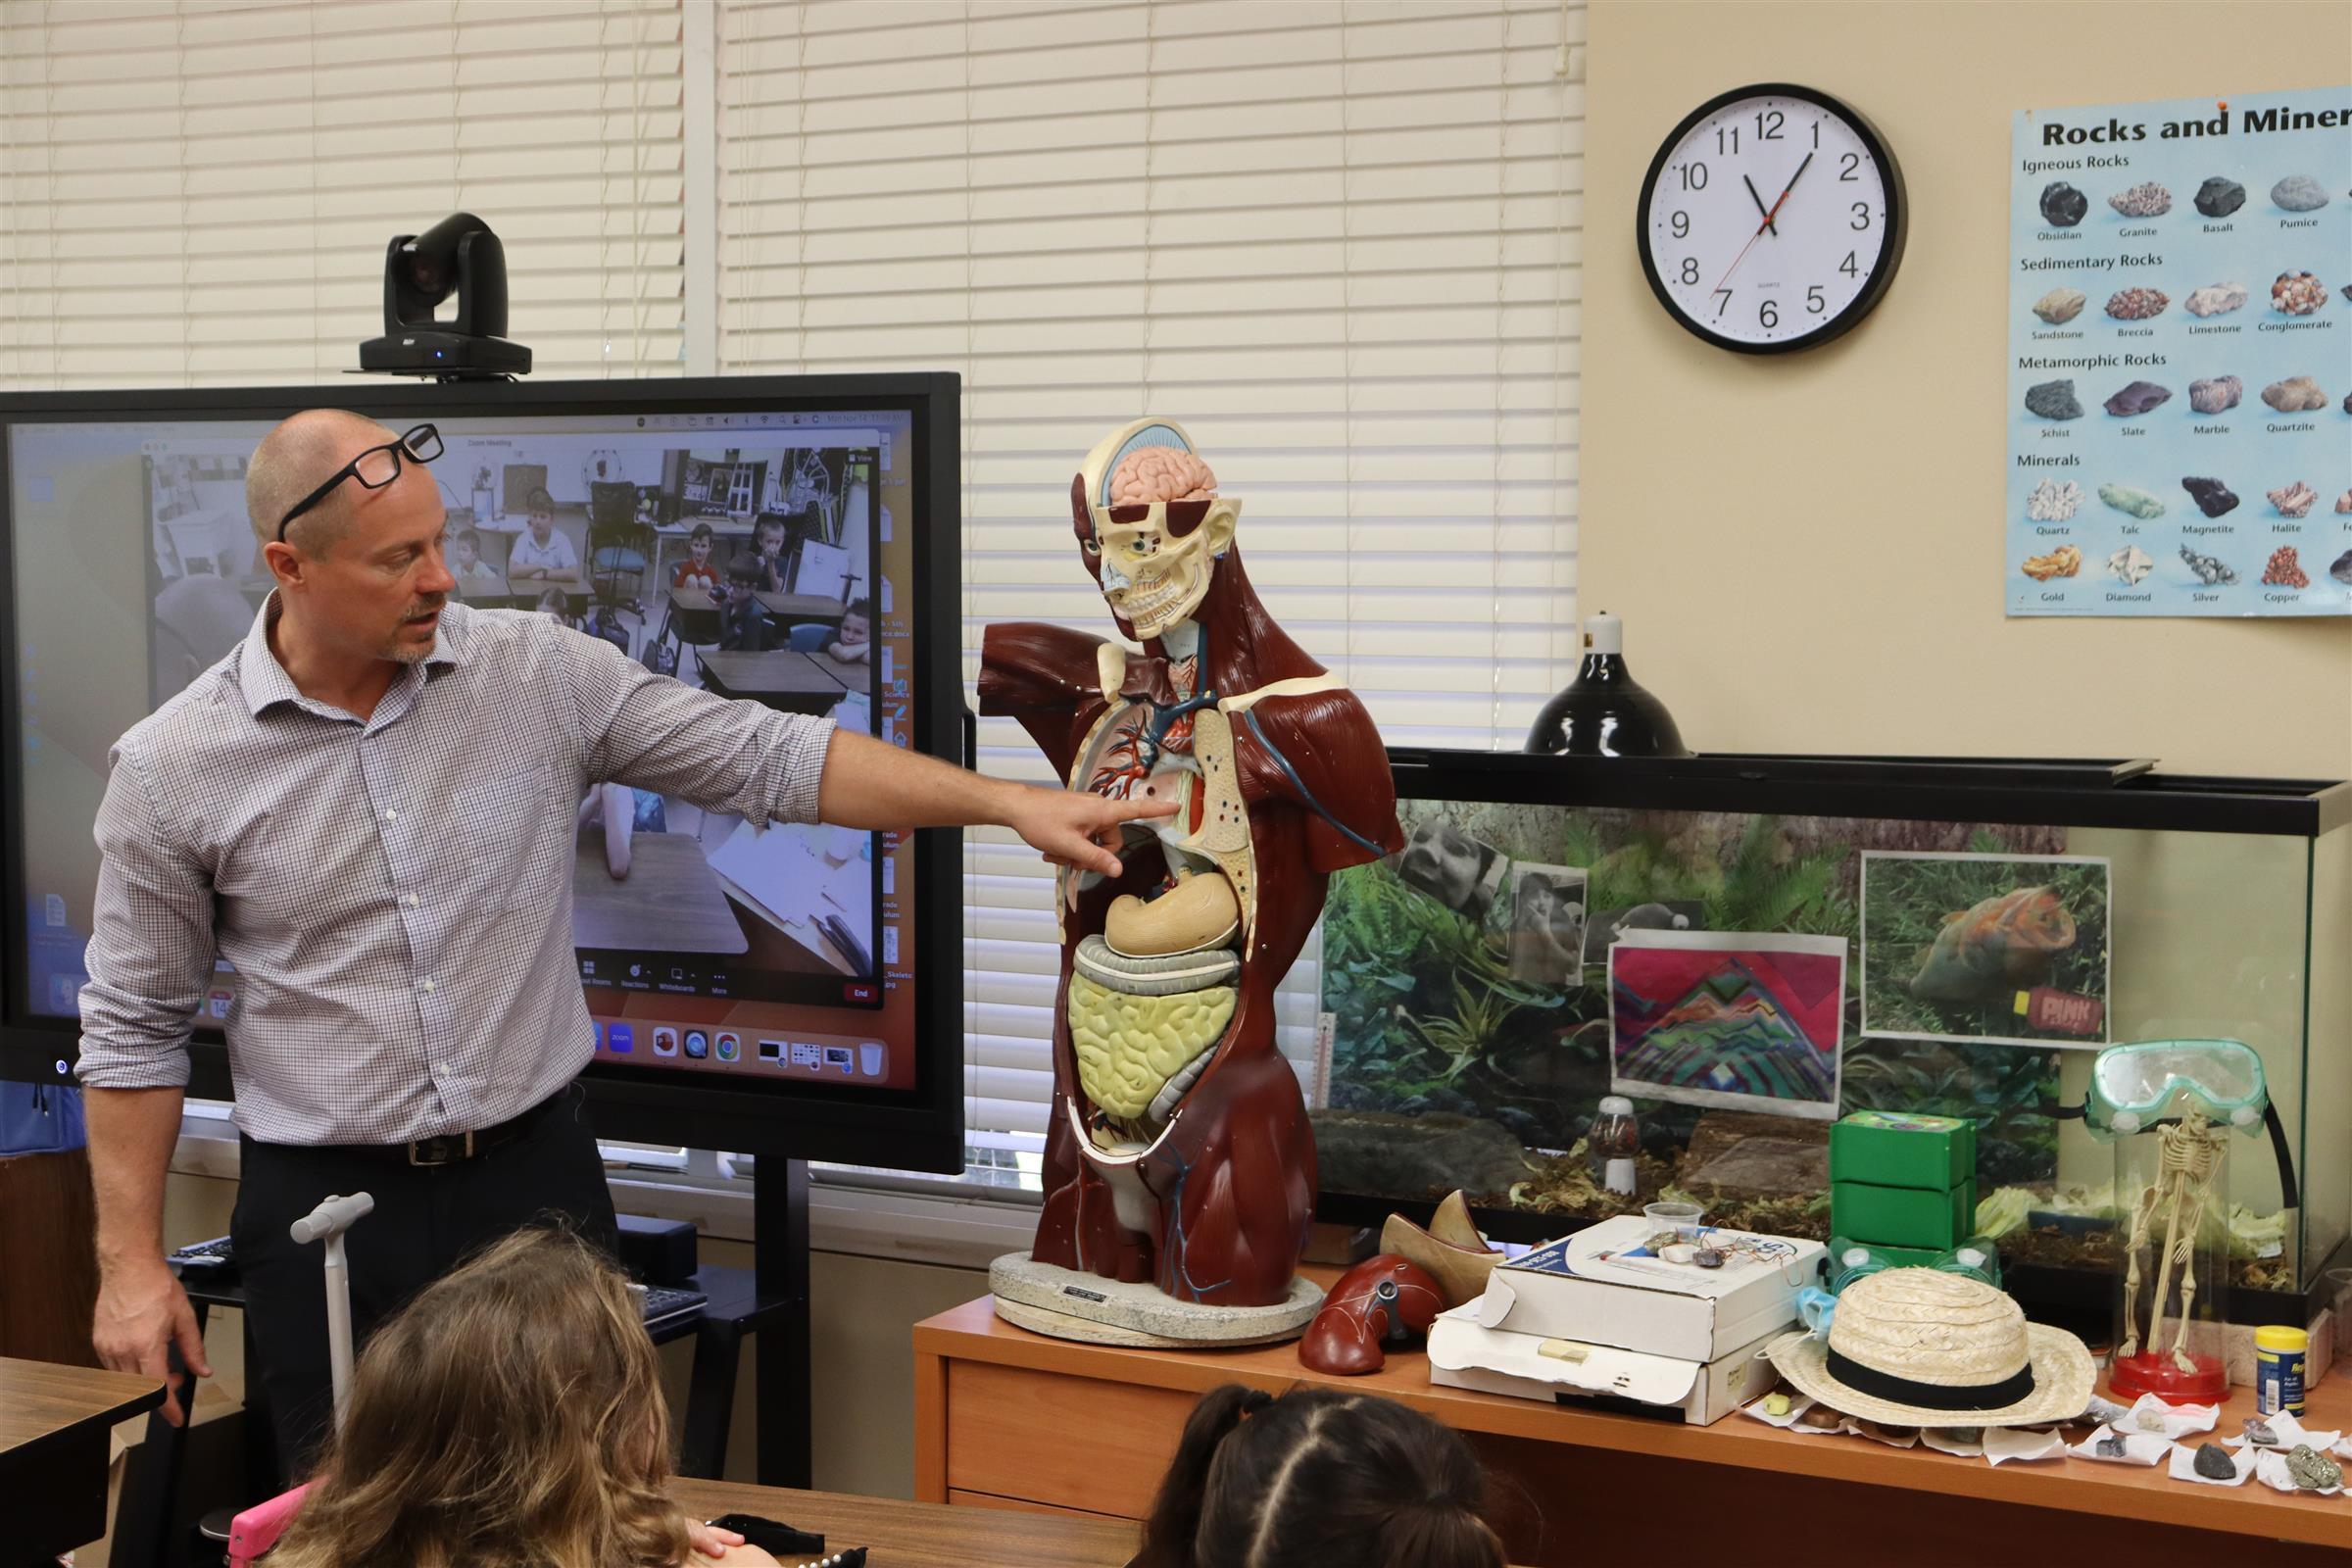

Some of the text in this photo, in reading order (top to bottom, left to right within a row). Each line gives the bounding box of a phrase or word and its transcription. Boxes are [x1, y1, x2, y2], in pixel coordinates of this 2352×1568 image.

[1754, 111, 1785, 140] 12
[2043, 119, 2146, 146] Rocks
[2160, 110, 2229, 139] and
[1716, 126, 1739, 156] 11
[1810, 121, 1819, 149] 1
[1838, 152, 1860, 181] 2
[2022, 155, 2130, 174] Igneous Rocks
[1680, 162, 1708, 191] 10
[1850, 202, 1870, 231] 3
[1671, 210, 1690, 239] 9
[2202, 222, 2233, 233] Basalt
[2279, 218, 2319, 228] Pumice
[2036, 230, 2082, 241] Obsidian
[2119, 226, 2158, 237] Granite
[1838, 249, 1859, 278] 4
[2021, 253, 2164, 271] Sedimentary Rocks
[1681, 257, 1700, 286] 8
[1715, 289, 1734, 317] 7
[1805, 285, 1826, 314] 5
[1759, 300, 1779, 328] 6
[2117, 326, 2154, 337] Breccia
[2188, 323, 2242, 335] Limestone
[2257, 319, 2332, 333] Conglomerate
[2032, 329, 2084, 339] Sandstone
[2018, 353, 2167, 370] Metamorphic Rocks
[2040, 427, 2071, 438] Schist
[2121, 426, 2145, 437] Slate
[2193, 424, 2230, 434] Marble
[2266, 421, 2315, 433] Quartzite
[2017, 454, 2081, 467] Minerals
[2035, 525, 2070, 536] Quartz
[2121, 524, 2140, 535] Talc
[2181, 523, 2234, 536] Magnetite
[2271, 522, 2302, 533] Halite
[2040, 592, 2065, 602] Gold
[2105, 592, 2151, 602] Diamond
[2192, 592, 2220, 602] Silver
[2263, 592, 2300, 604] Copper
[854, 989, 868, 998] End
[213, 1001, 226, 1013] 14
[2041, 997, 2090, 1021] PINK
